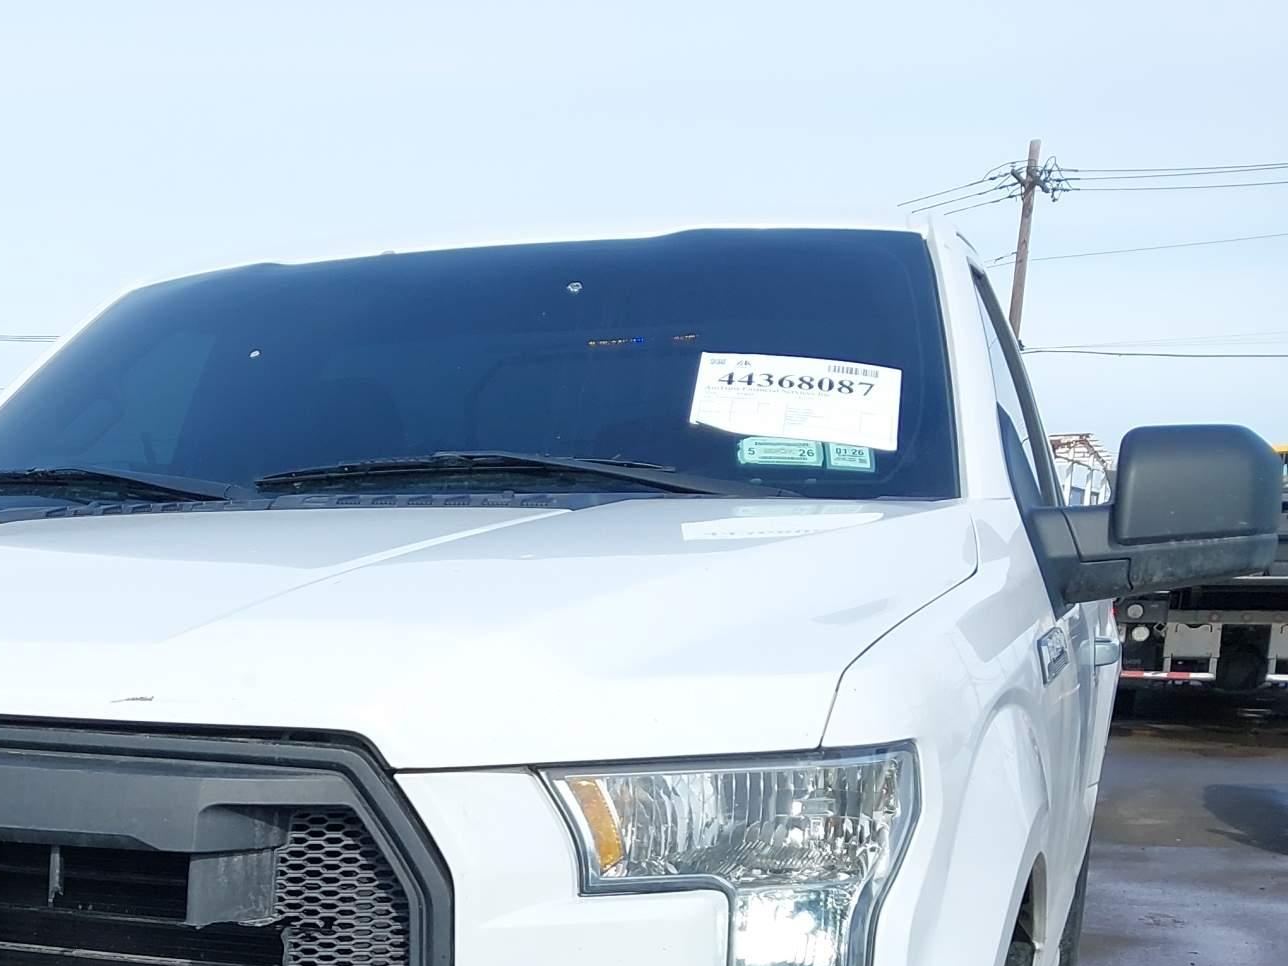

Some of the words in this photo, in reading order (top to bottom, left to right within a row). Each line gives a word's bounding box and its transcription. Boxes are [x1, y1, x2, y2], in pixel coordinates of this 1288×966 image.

[717, 371, 876, 397] 44368087
[747, 447, 756, 456] 5
[798, 448, 815, 458] 26
[851, 448, 865, 456] 26
